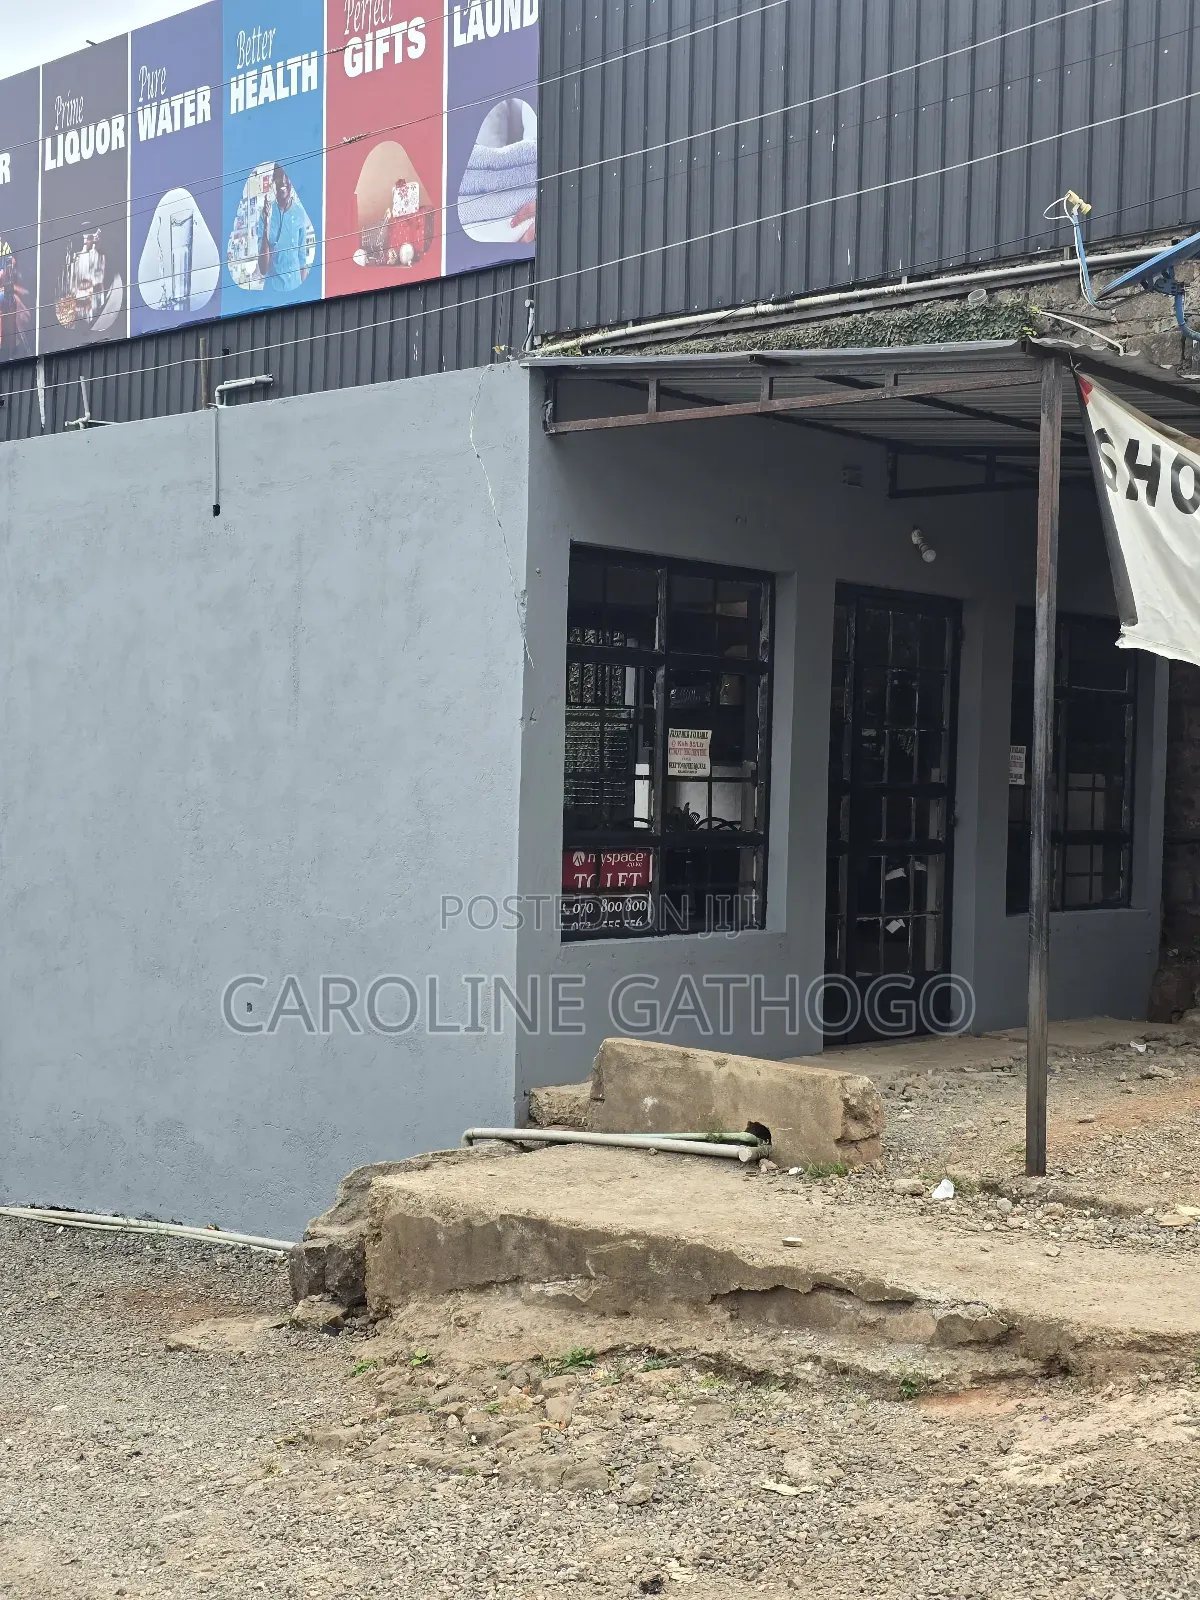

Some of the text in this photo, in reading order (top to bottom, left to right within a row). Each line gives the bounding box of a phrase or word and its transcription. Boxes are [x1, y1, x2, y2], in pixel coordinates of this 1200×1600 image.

[236, 25, 277, 69] Better
[344, 16, 426, 77] GIFTS
[454, 0, 539, 47] LAUND
[138, 65, 167, 102] Pure
[230, 50, 318, 114] HEALTH
[54, 89, 84, 131] Prime
[136, 85, 211, 142] WATER
[45, 113, 125, 171] LIQUOR
[1094, 428, 1200, 514] SHO
[573, 897, 647, 917] 070 800 800
